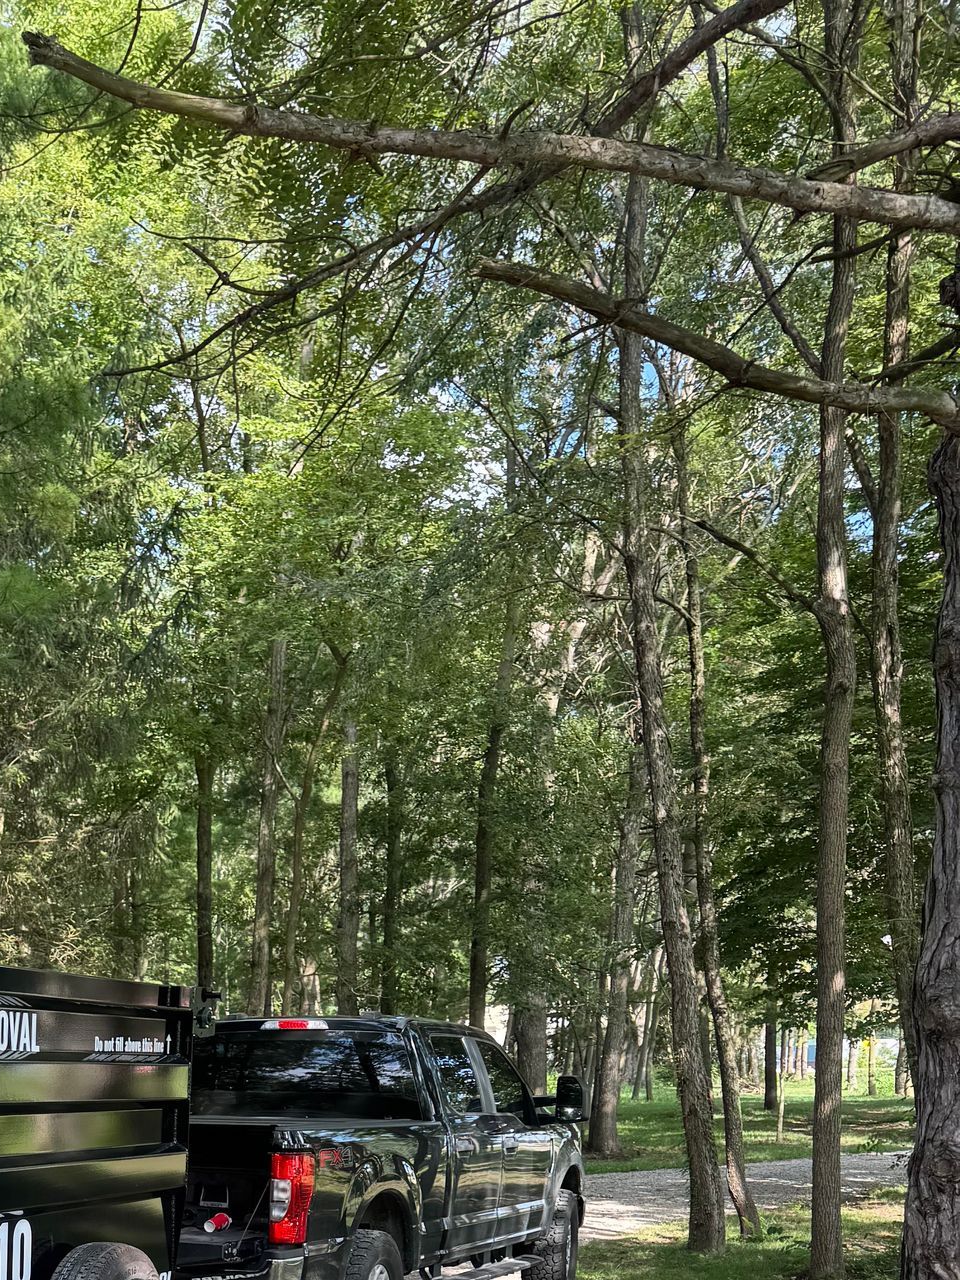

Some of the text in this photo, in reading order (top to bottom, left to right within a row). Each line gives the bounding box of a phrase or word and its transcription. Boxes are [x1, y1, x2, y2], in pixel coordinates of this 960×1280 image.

[94, 1036, 164, 1053] Do not fill above this line
[319, 1146, 353, 1169] FX4
